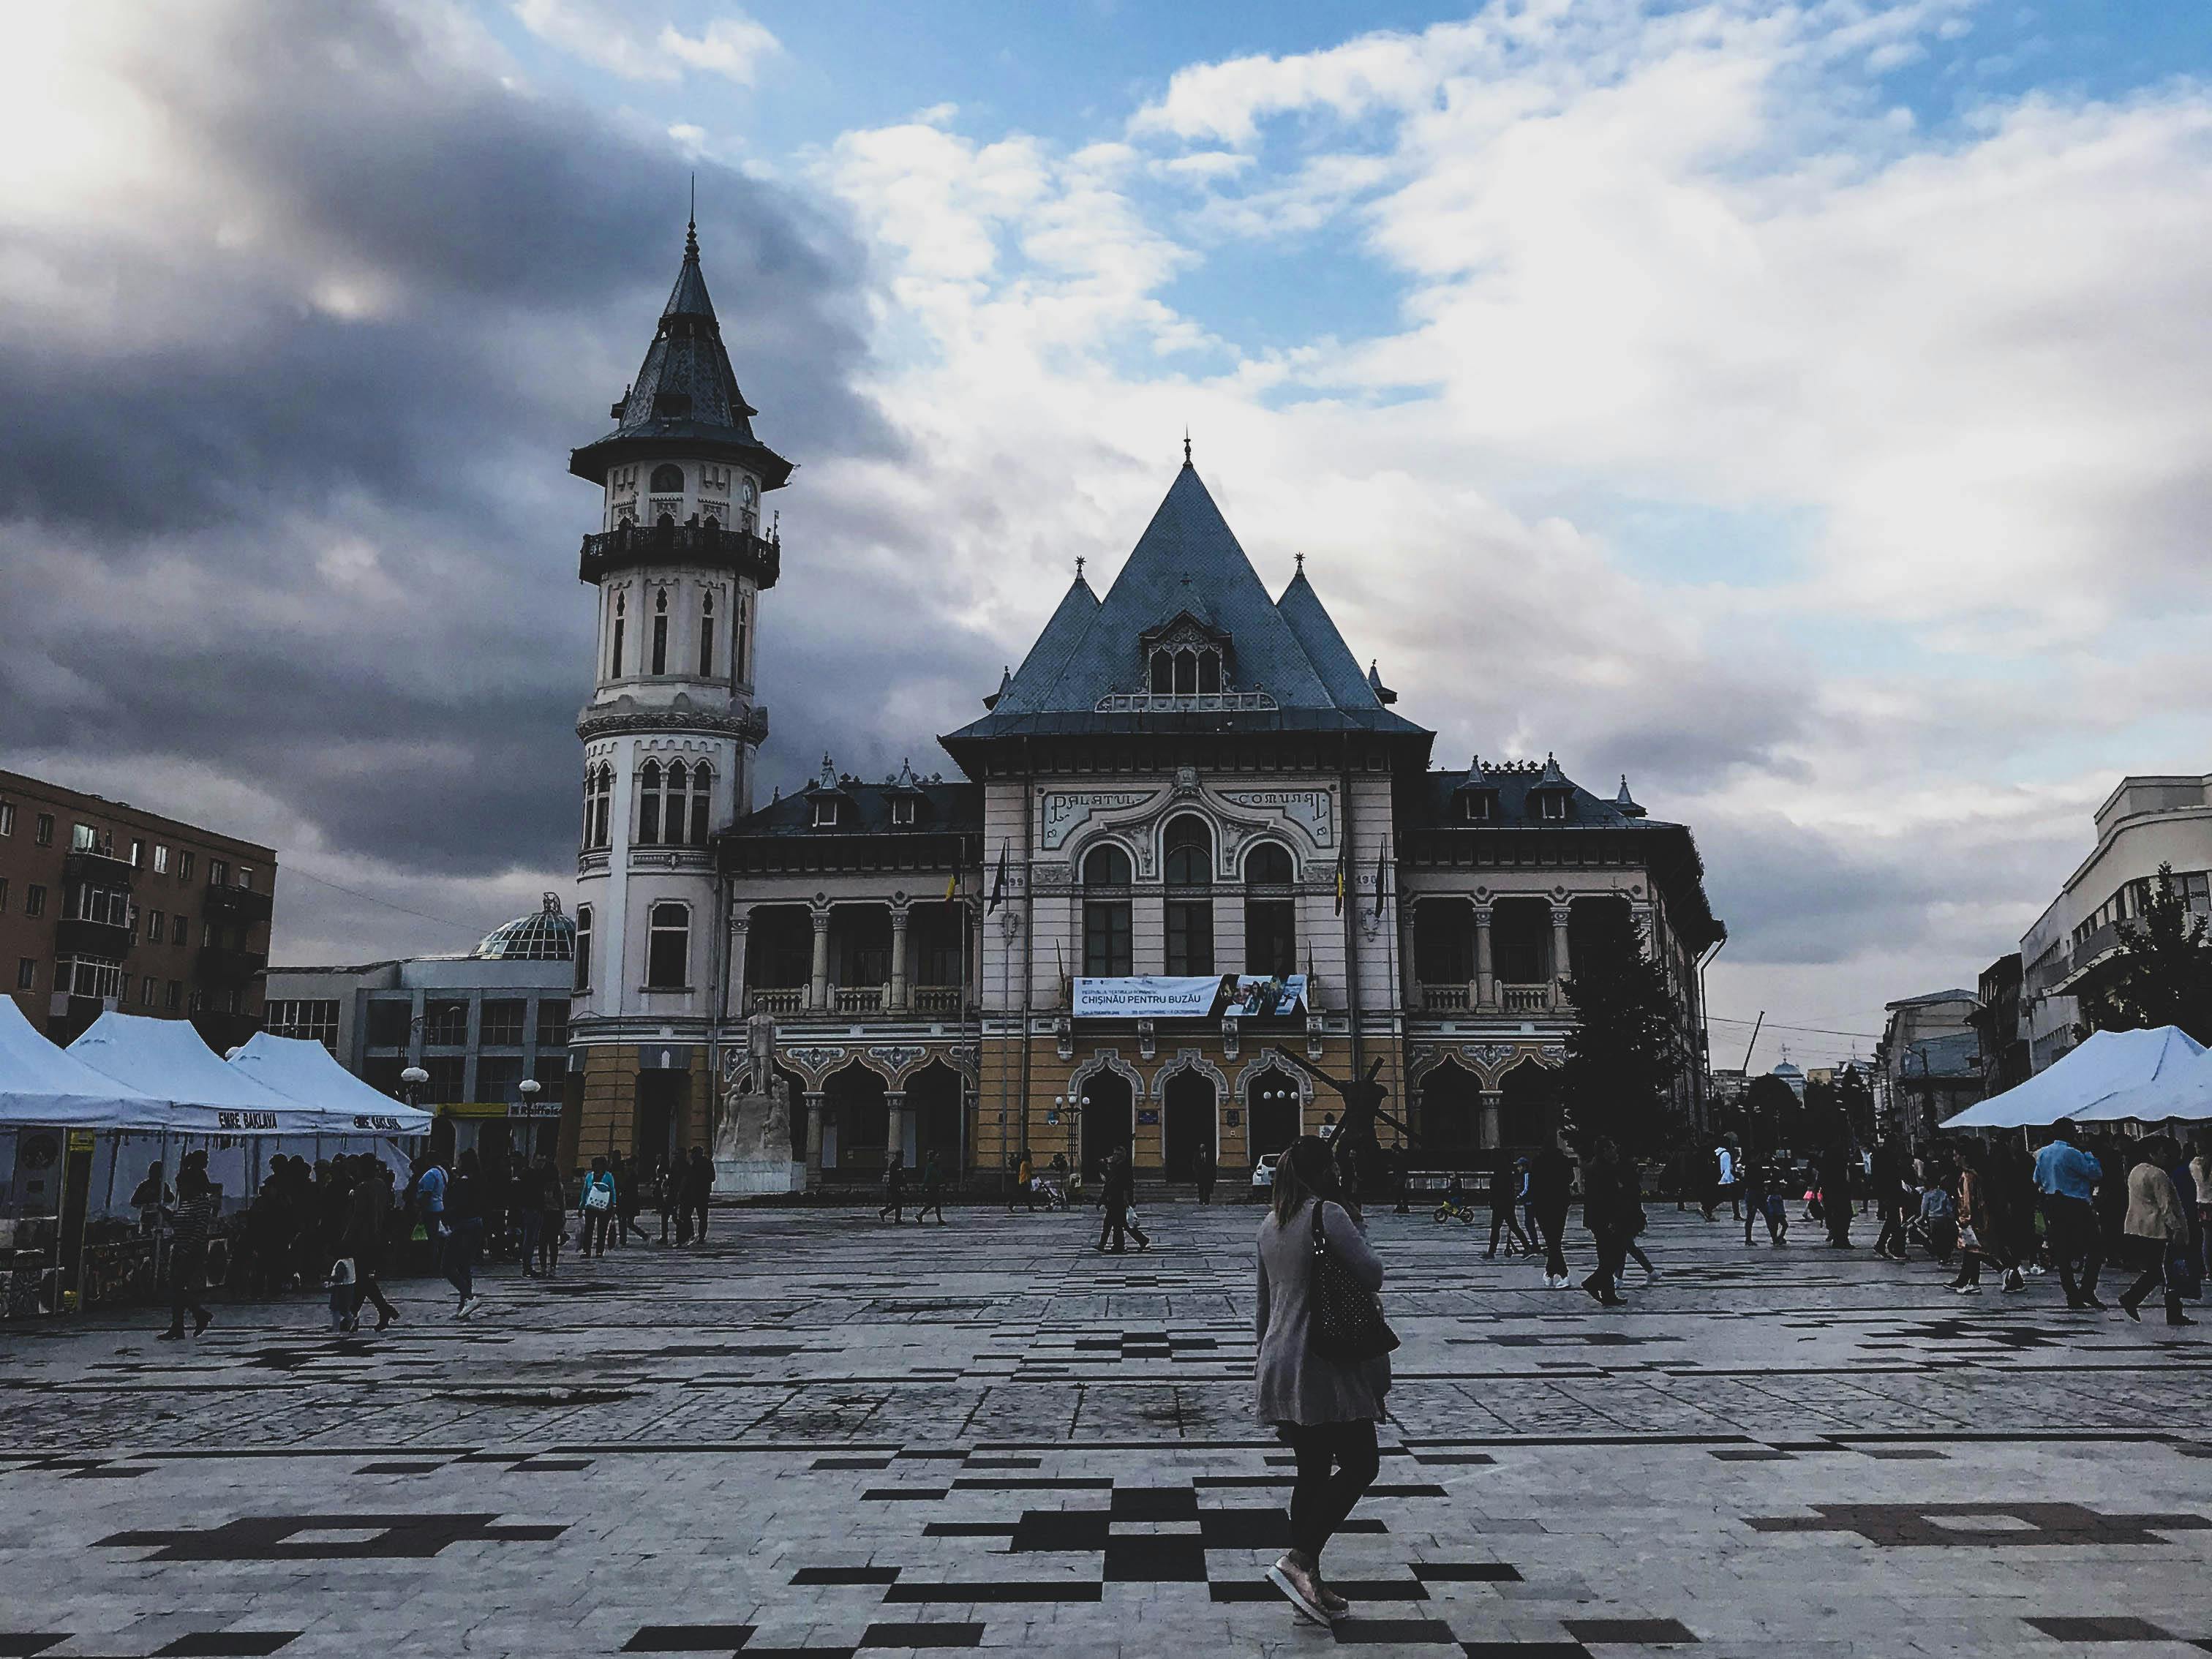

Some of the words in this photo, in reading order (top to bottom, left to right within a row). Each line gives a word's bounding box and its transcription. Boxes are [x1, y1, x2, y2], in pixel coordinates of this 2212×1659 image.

[1127, 996, 1166, 1004] PENTRU
[1168, 993, 1201, 1004] BUZĂU
[521, 1104, 562, 1116] Raiffeis
[219, 1112, 241, 1129] EMRE
[242, 1112, 278, 1129] BAKLAVA
